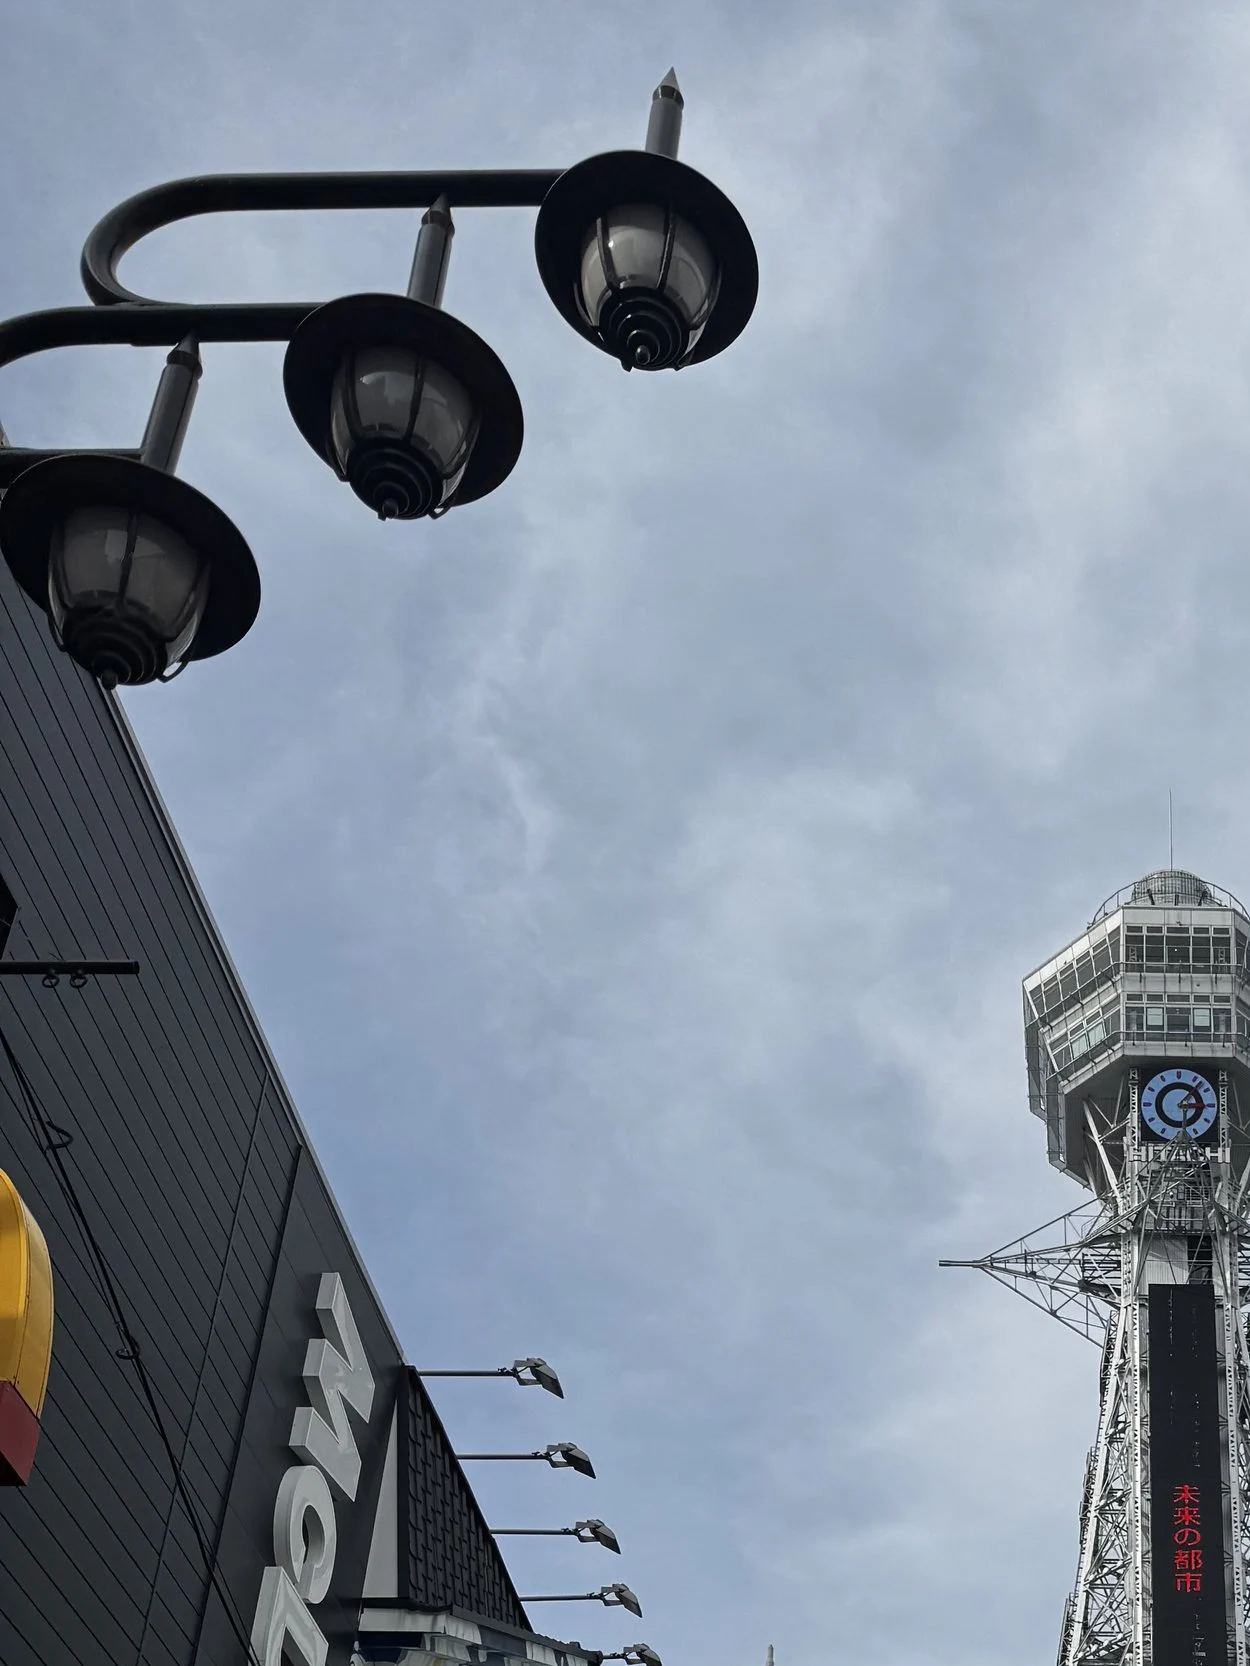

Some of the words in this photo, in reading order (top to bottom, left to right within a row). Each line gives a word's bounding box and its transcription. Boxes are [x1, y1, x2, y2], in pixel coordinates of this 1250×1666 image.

[1173, 1484, 1203, 1593] 未来の都市
